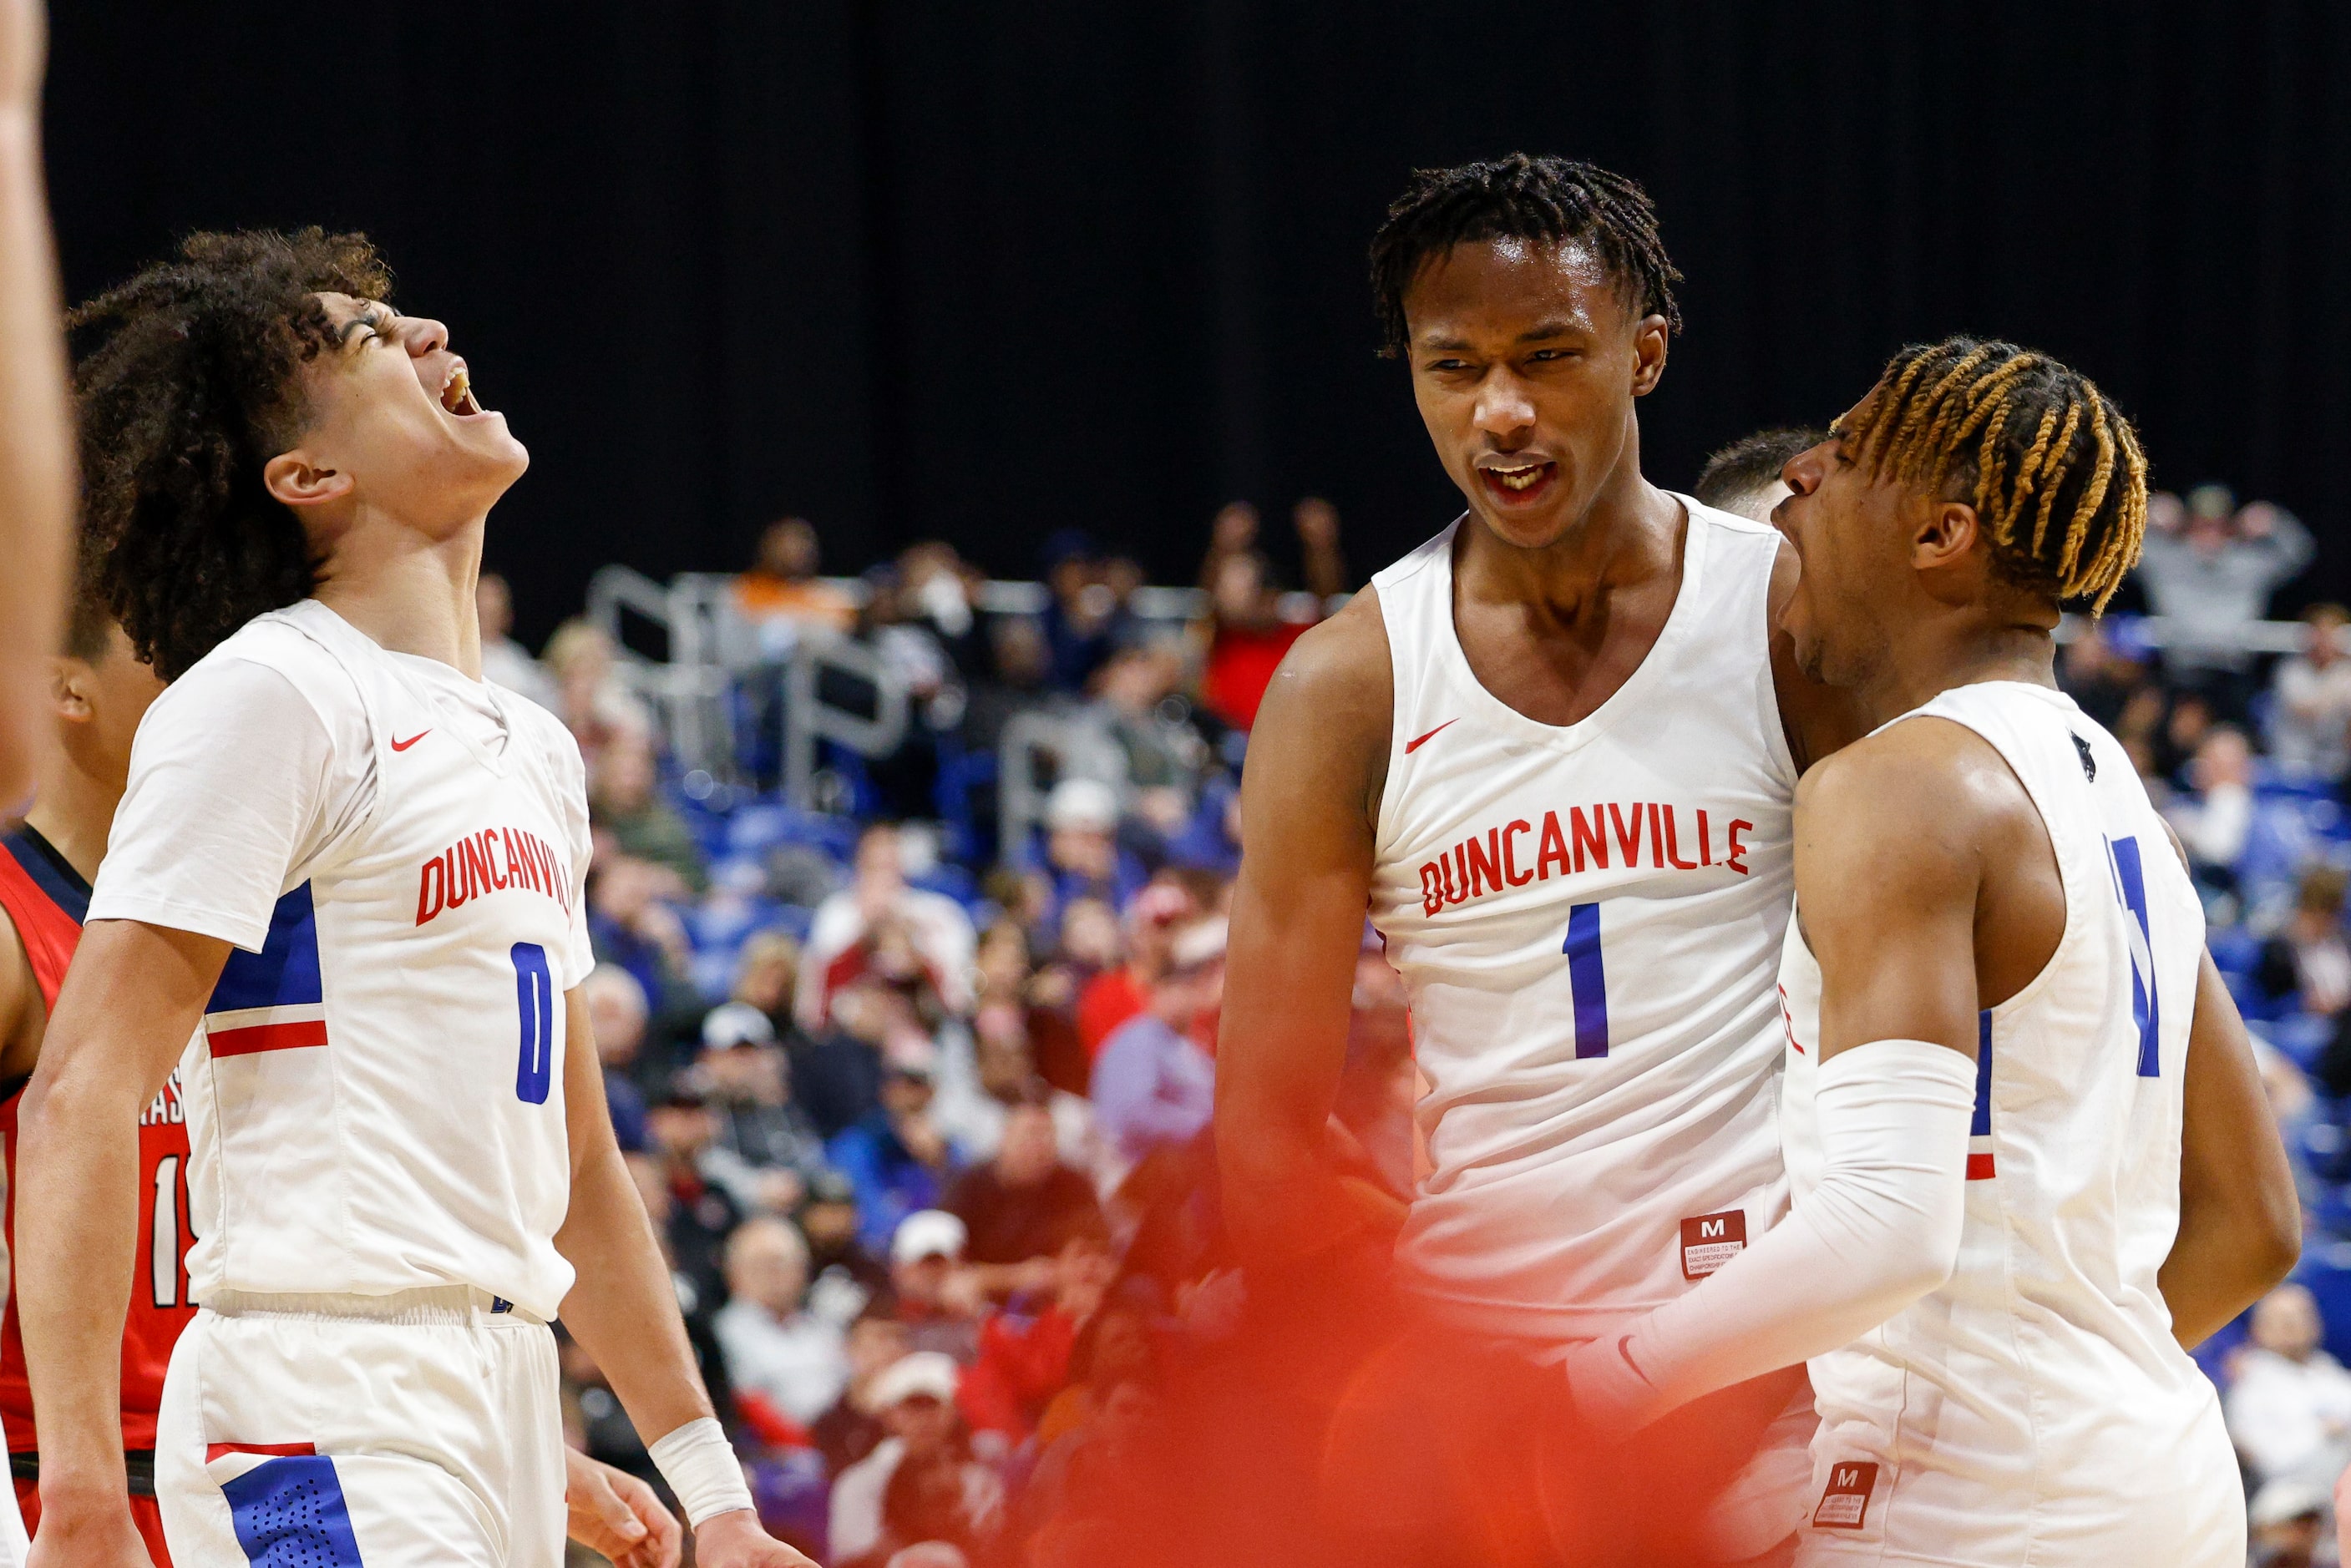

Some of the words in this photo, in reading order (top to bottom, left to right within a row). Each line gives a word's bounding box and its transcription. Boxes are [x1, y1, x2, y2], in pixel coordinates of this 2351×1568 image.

[1419, 802, 1752, 918] DUNCANVILLE
[1562, 902, 1609, 1059] 1
[510, 941, 552, 1105] 0
[1687, 1246, 1720, 1255] ENGINEERED
[1701, 1219, 1725, 1237] M
[1837, 1469, 1859, 1487] M
